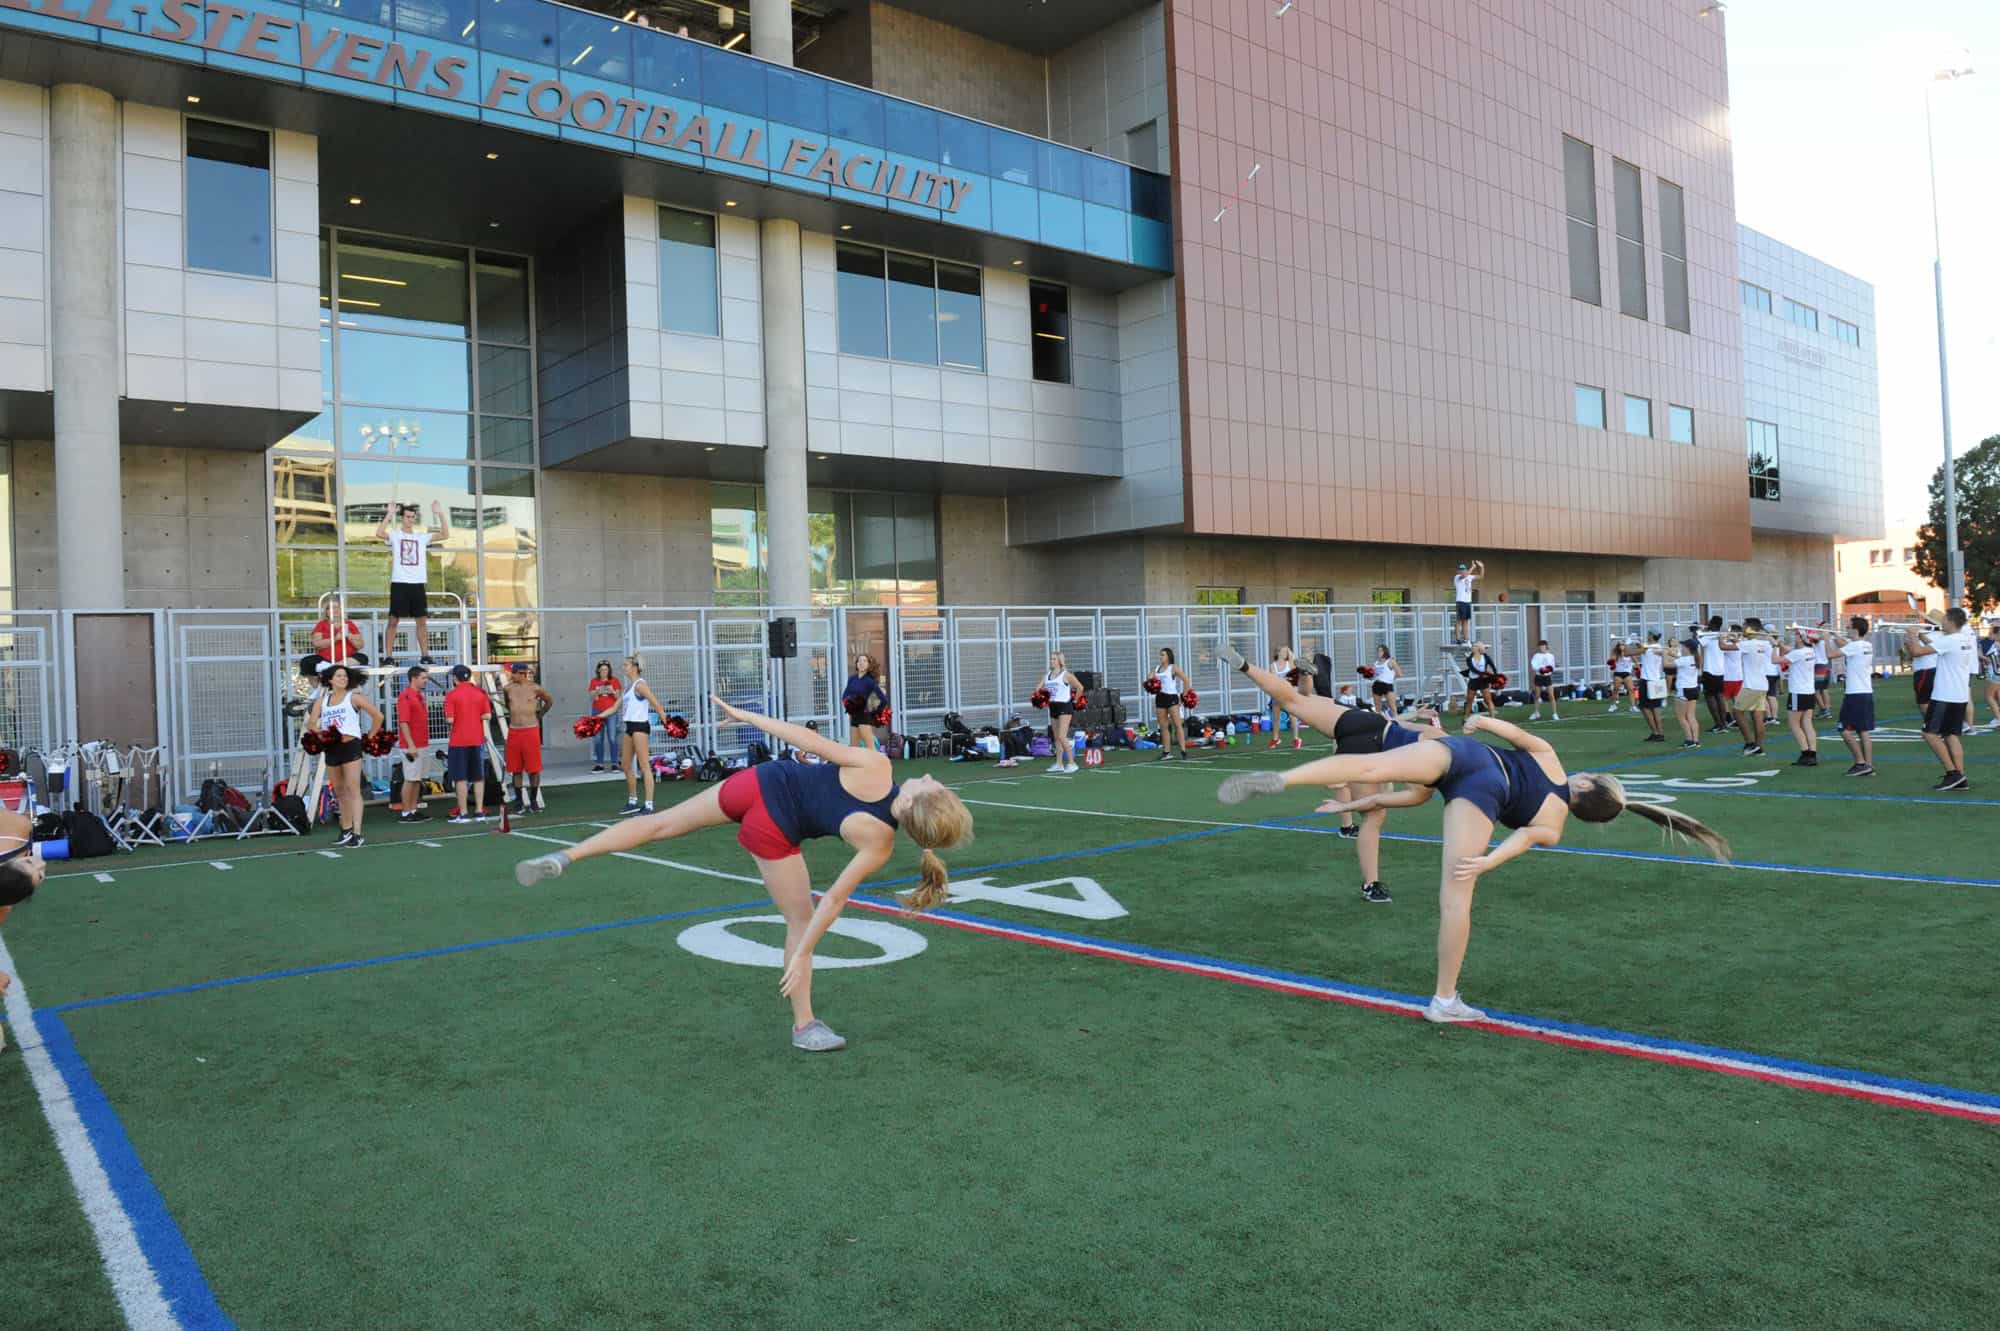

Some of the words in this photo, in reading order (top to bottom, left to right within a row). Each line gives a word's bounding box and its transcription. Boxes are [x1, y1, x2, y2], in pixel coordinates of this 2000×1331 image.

[484, 67, 766, 169] FOOTBALL
[781, 137, 975, 213] FACILITY
[1085, 748, 1102, 766] 40
